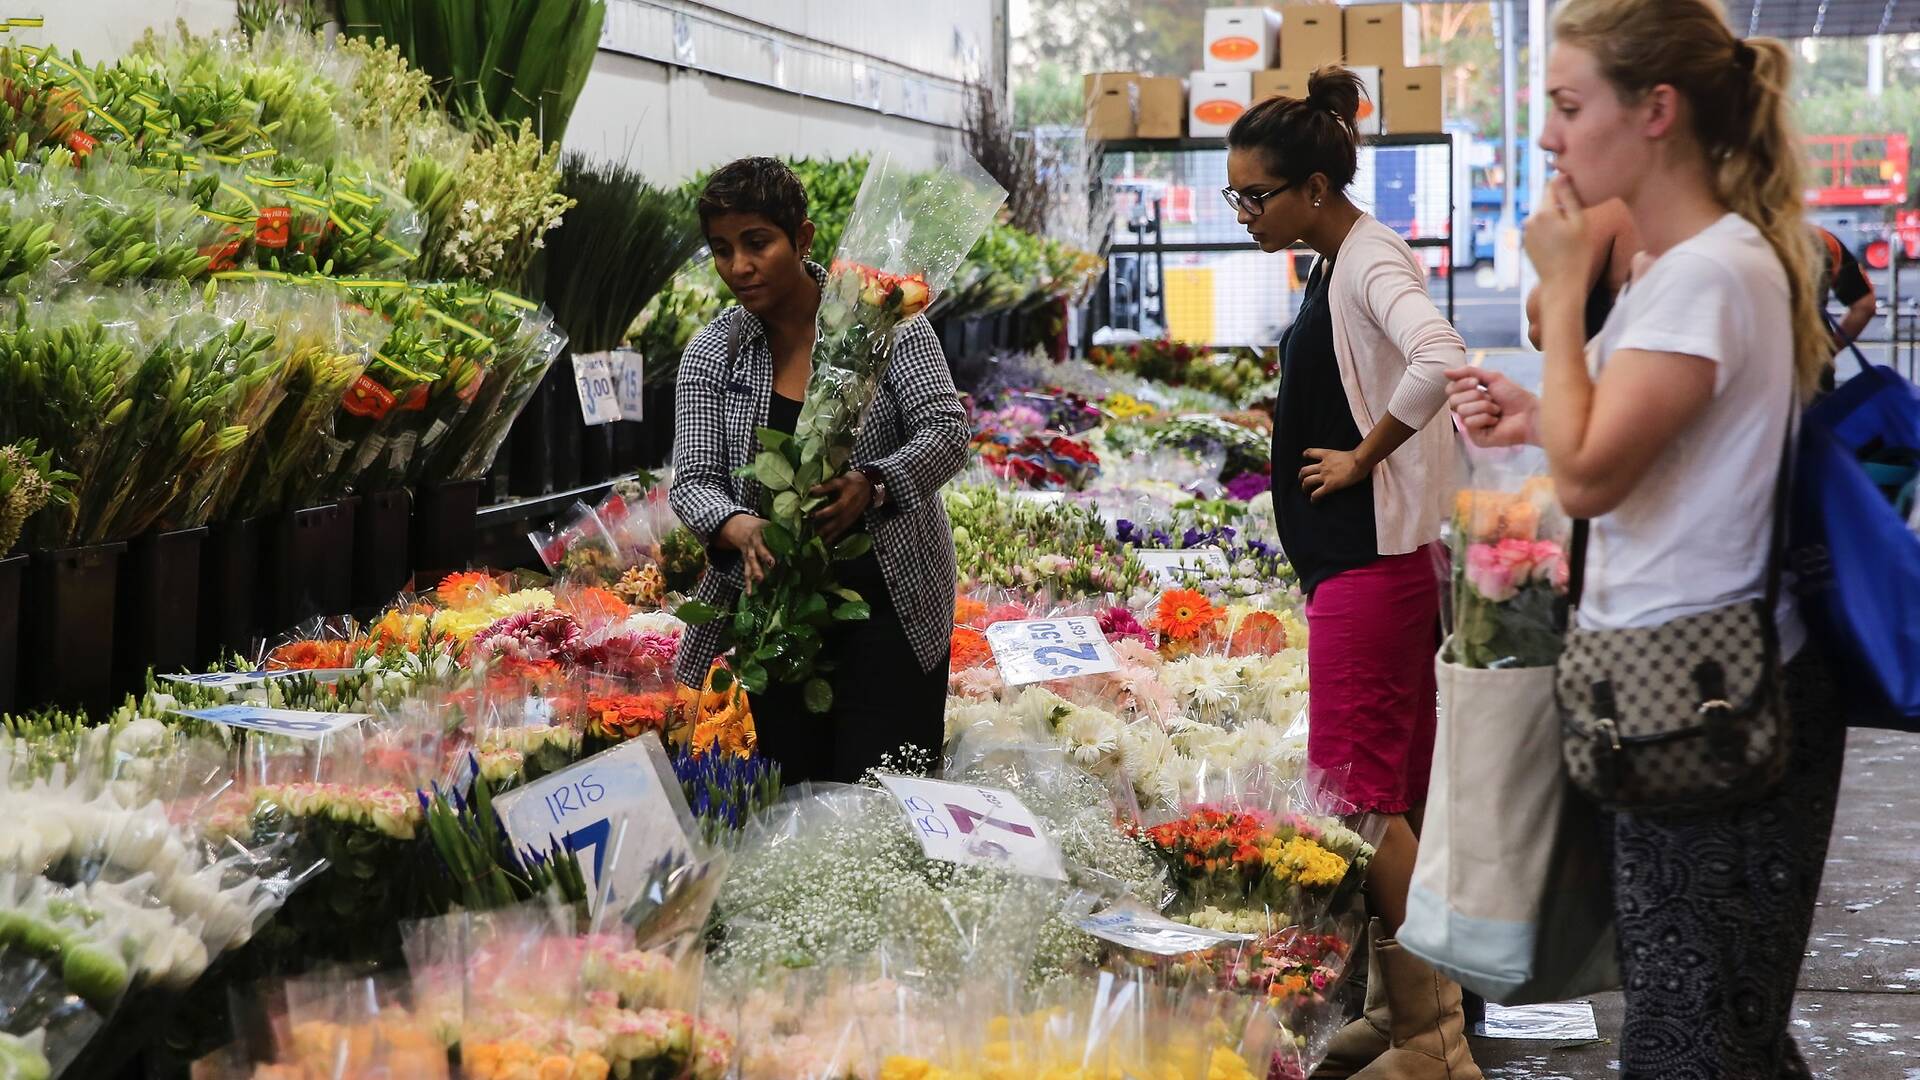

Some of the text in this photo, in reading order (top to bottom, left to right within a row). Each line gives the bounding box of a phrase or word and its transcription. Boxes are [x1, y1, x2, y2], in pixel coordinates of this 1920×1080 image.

[545, 774, 605, 824] IRIS
[904, 795, 949, 839] BB
[561, 817, 617, 904] 7
